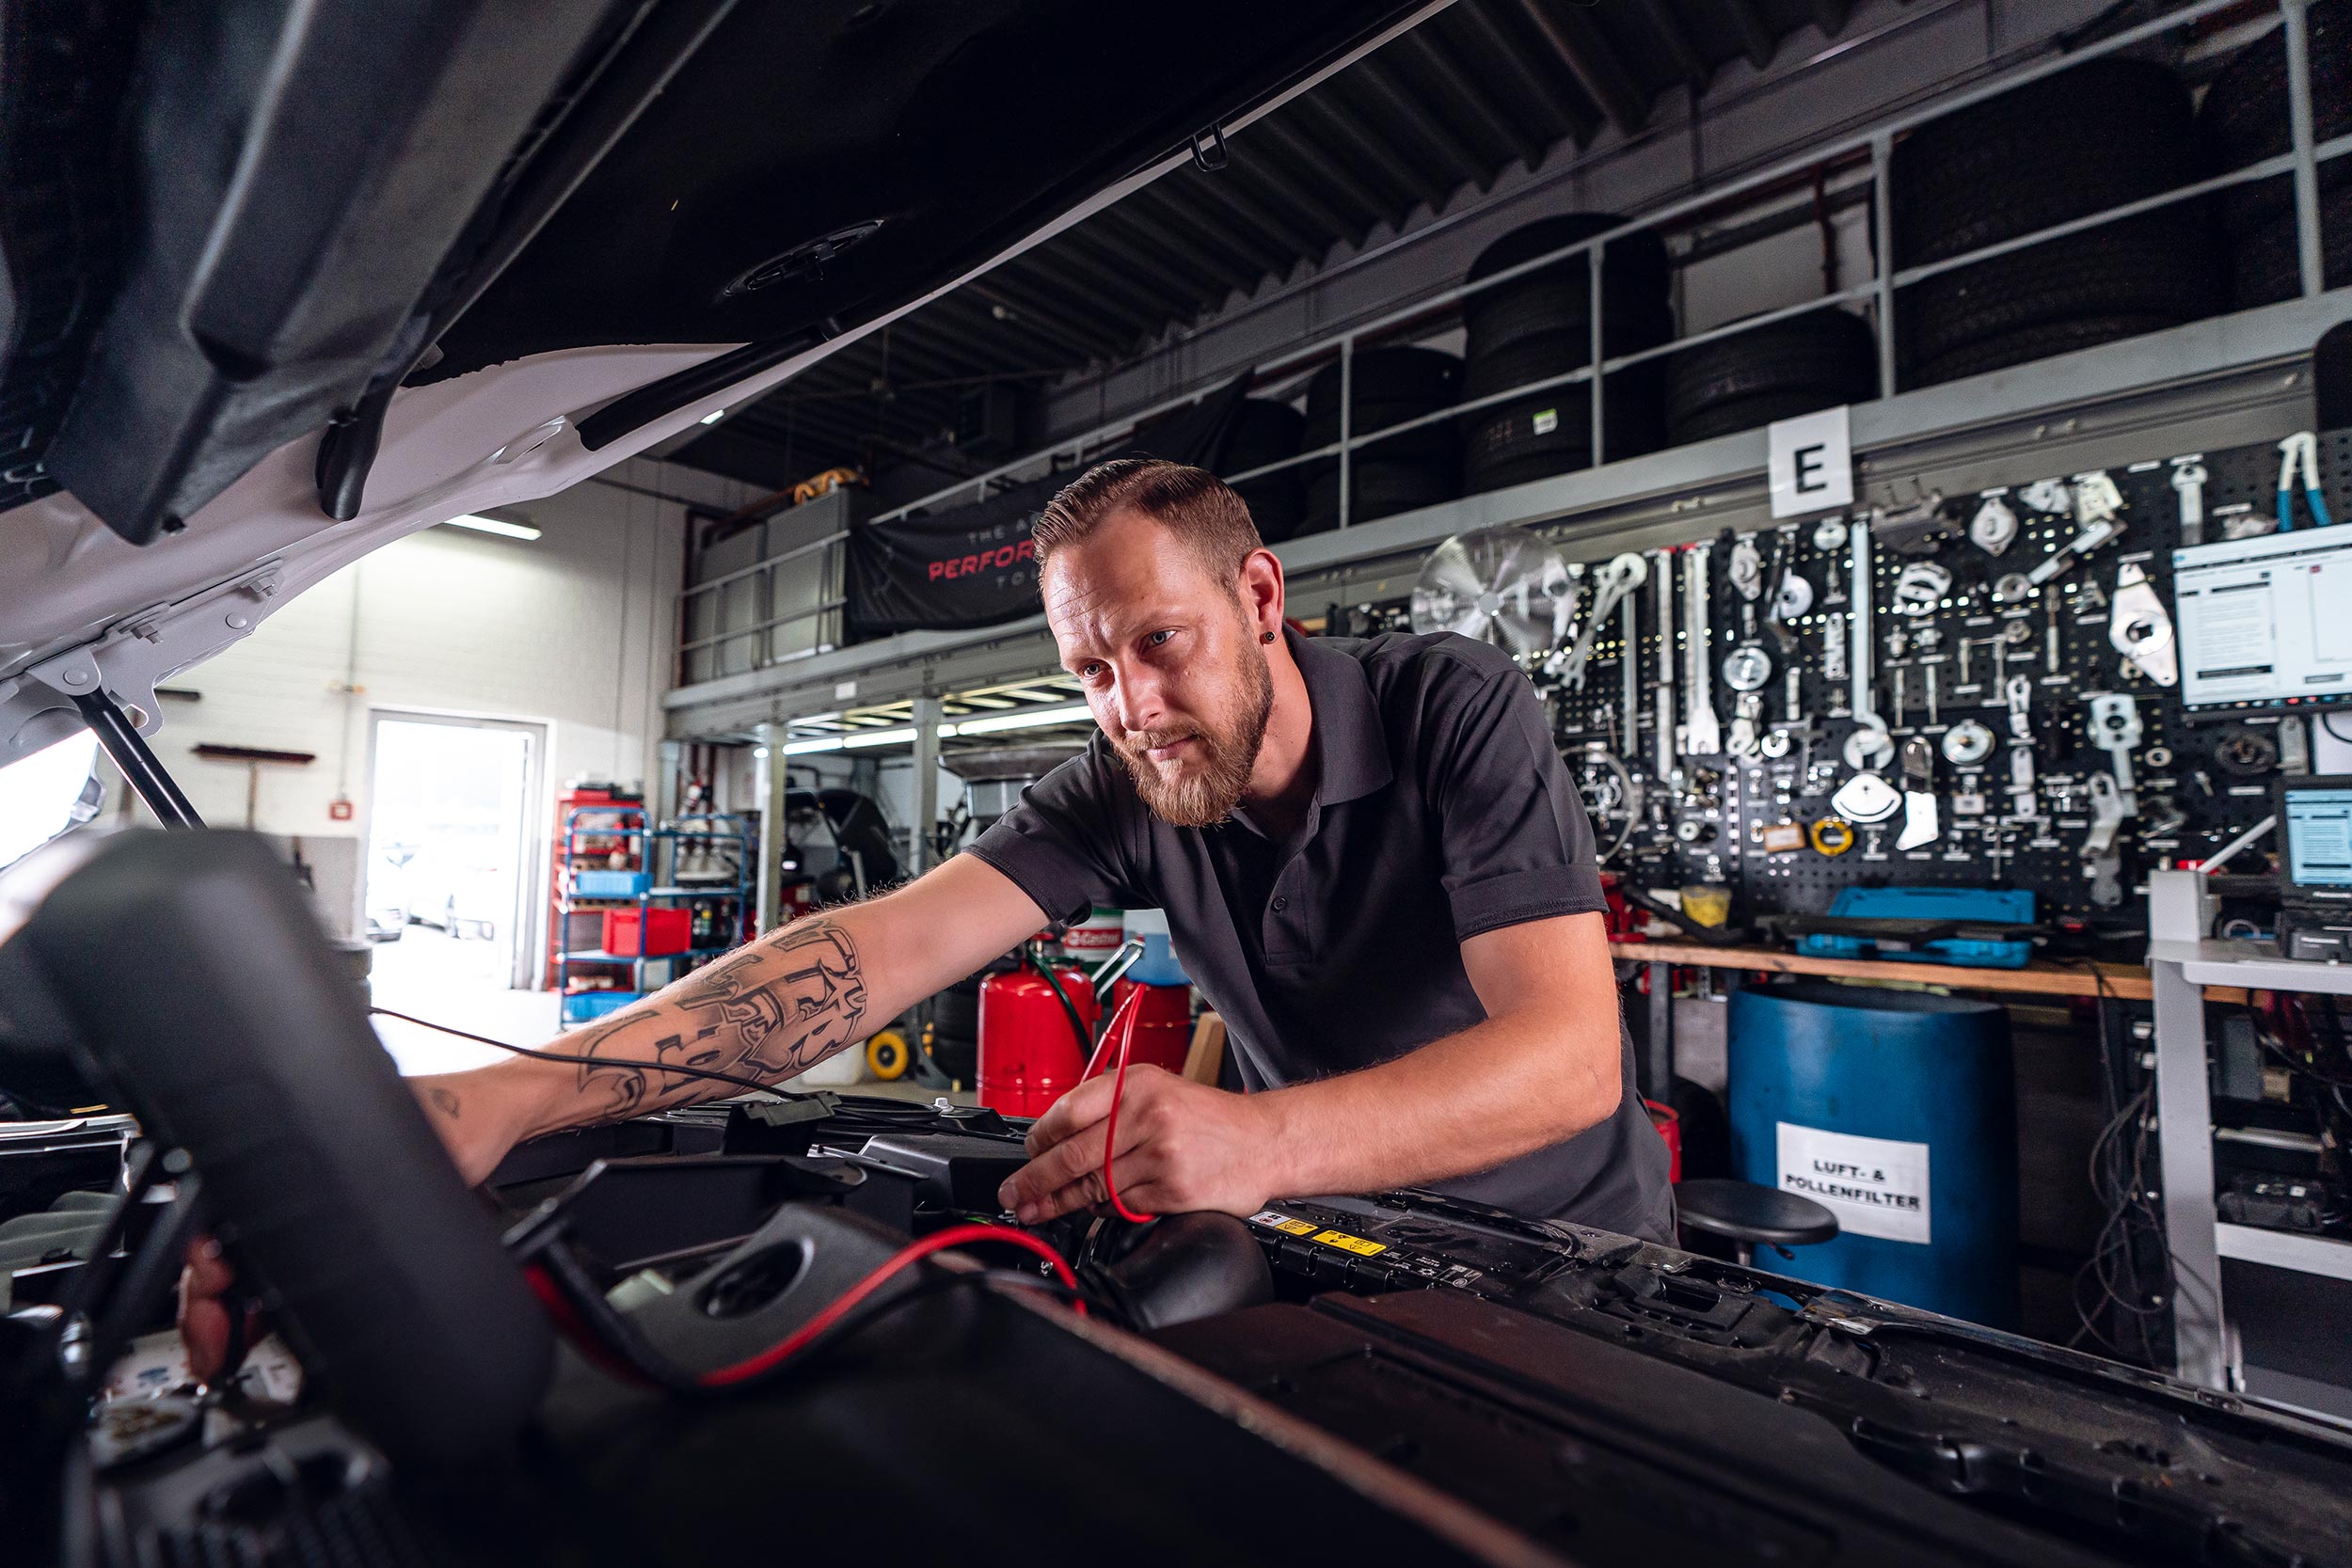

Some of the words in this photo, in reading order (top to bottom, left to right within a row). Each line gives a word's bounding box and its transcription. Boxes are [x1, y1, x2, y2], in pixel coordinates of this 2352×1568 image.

[1794, 444, 1827, 494] E
[968, 526, 1005, 544] THE
[1814, 1160, 1866, 1178] LUFT-
[1873, 1169, 1884, 1181] &
[1785, 1173, 1921, 1210] POLLENFILTER
